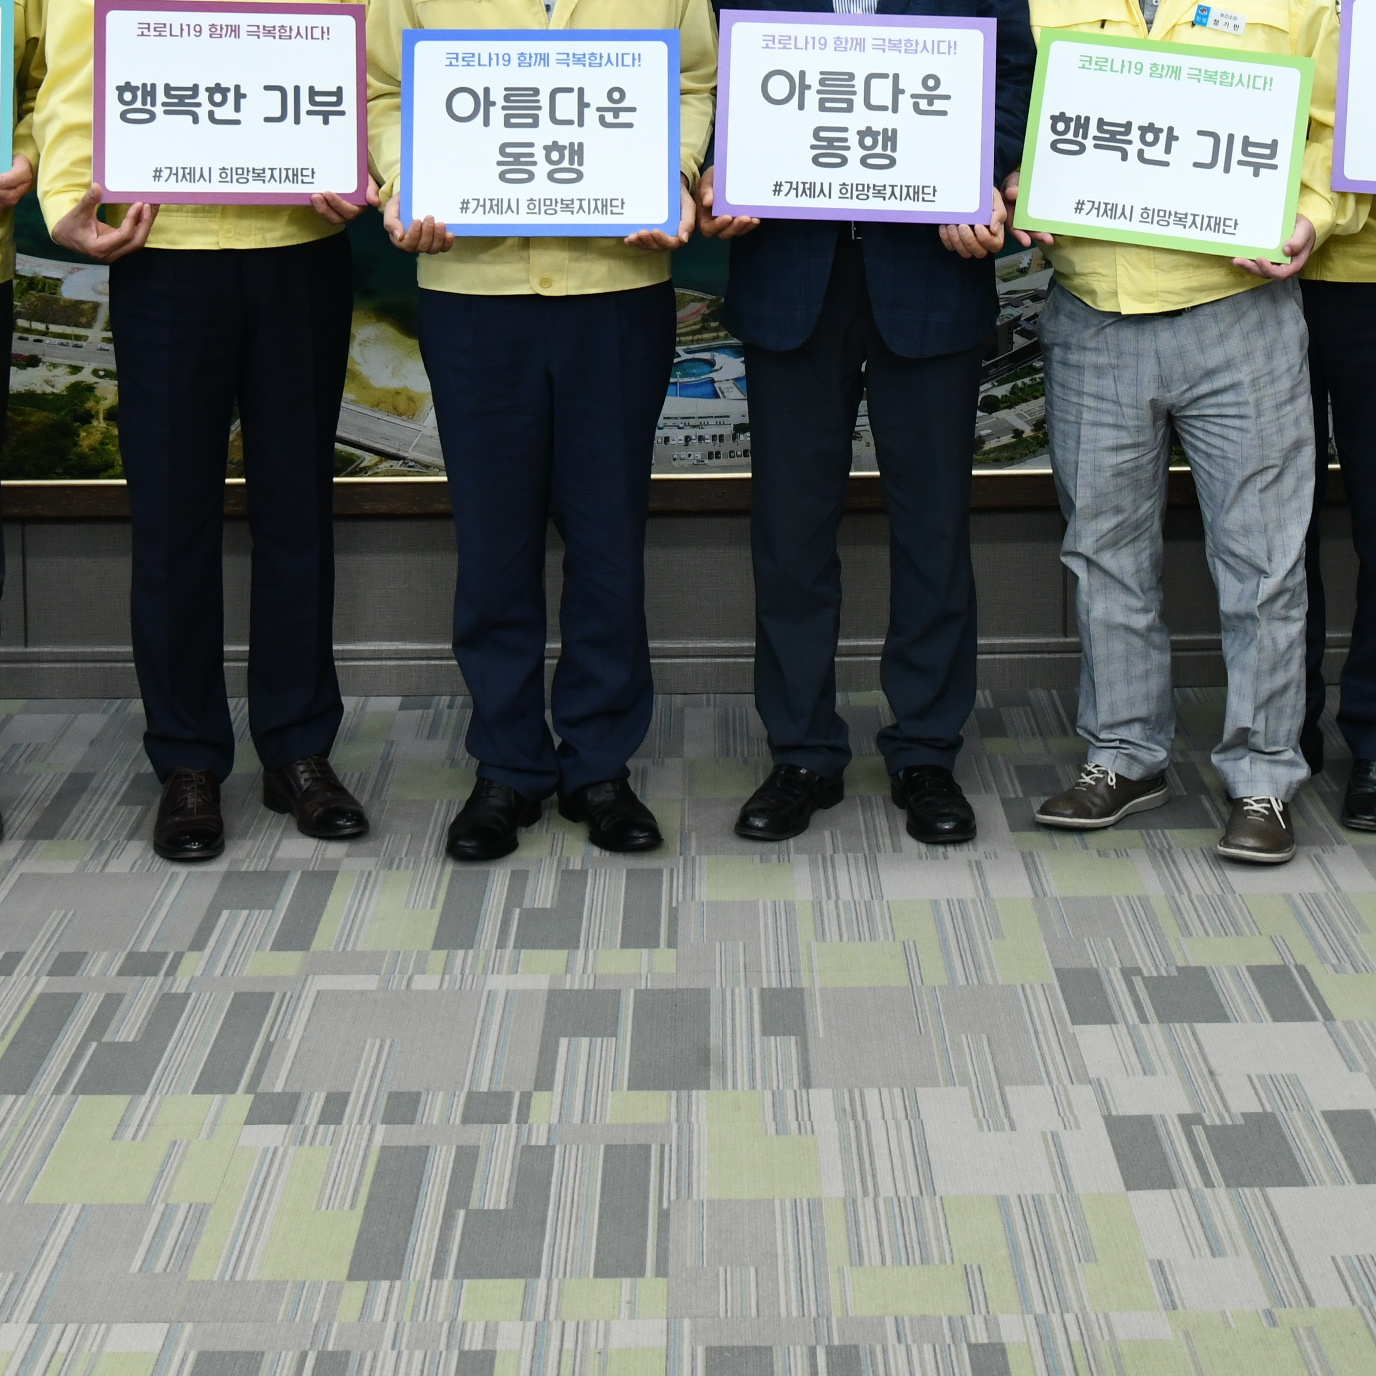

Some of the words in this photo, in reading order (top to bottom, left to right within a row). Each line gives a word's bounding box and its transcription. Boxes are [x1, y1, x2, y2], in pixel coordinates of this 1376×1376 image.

[136, 22, 203, 38] 코로나19
[208, 23, 241, 40] 함께
[245, 24, 330, 41] 극복합시다!
[760, 34, 828, 51] 코로나19
[833, 35, 866, 53] 함께
[871, 37, 958, 56] 극복합시다!
[444, 52, 512, 68] 코로나19
[516, 51, 550, 68] 함께
[555, 51, 642, 68] 극복합시다!
[1077, 54, 1144, 76] 코로나19
[1148, 62, 1183, 81] 함께
[1186, 65, 1274, 91] 극복합시다!
[115, 80, 248, 126] 행복한
[262, 84, 347, 126] 기부
[445, 86, 638, 129] 아름다운
[760, 68, 952, 117] 아름다운
[495, 140, 585, 185] 동행
[809, 125, 898, 171] 동행
[1050, 112, 1179, 167] 행복한
[1192, 129, 1279, 178] 기부
[151, 166, 212, 184] #거제시
[218, 166, 316, 185] 희망복지재단
[771, 180, 832, 200] #거제시
[837, 181, 938, 203] 희망복지재단
[459, 197, 520, 216] #거제시
[525, 197, 626, 216] 희망복지재단
[1073, 198, 1134, 223] #거제시
[1137, 205, 1239, 236] 희망복지재단
